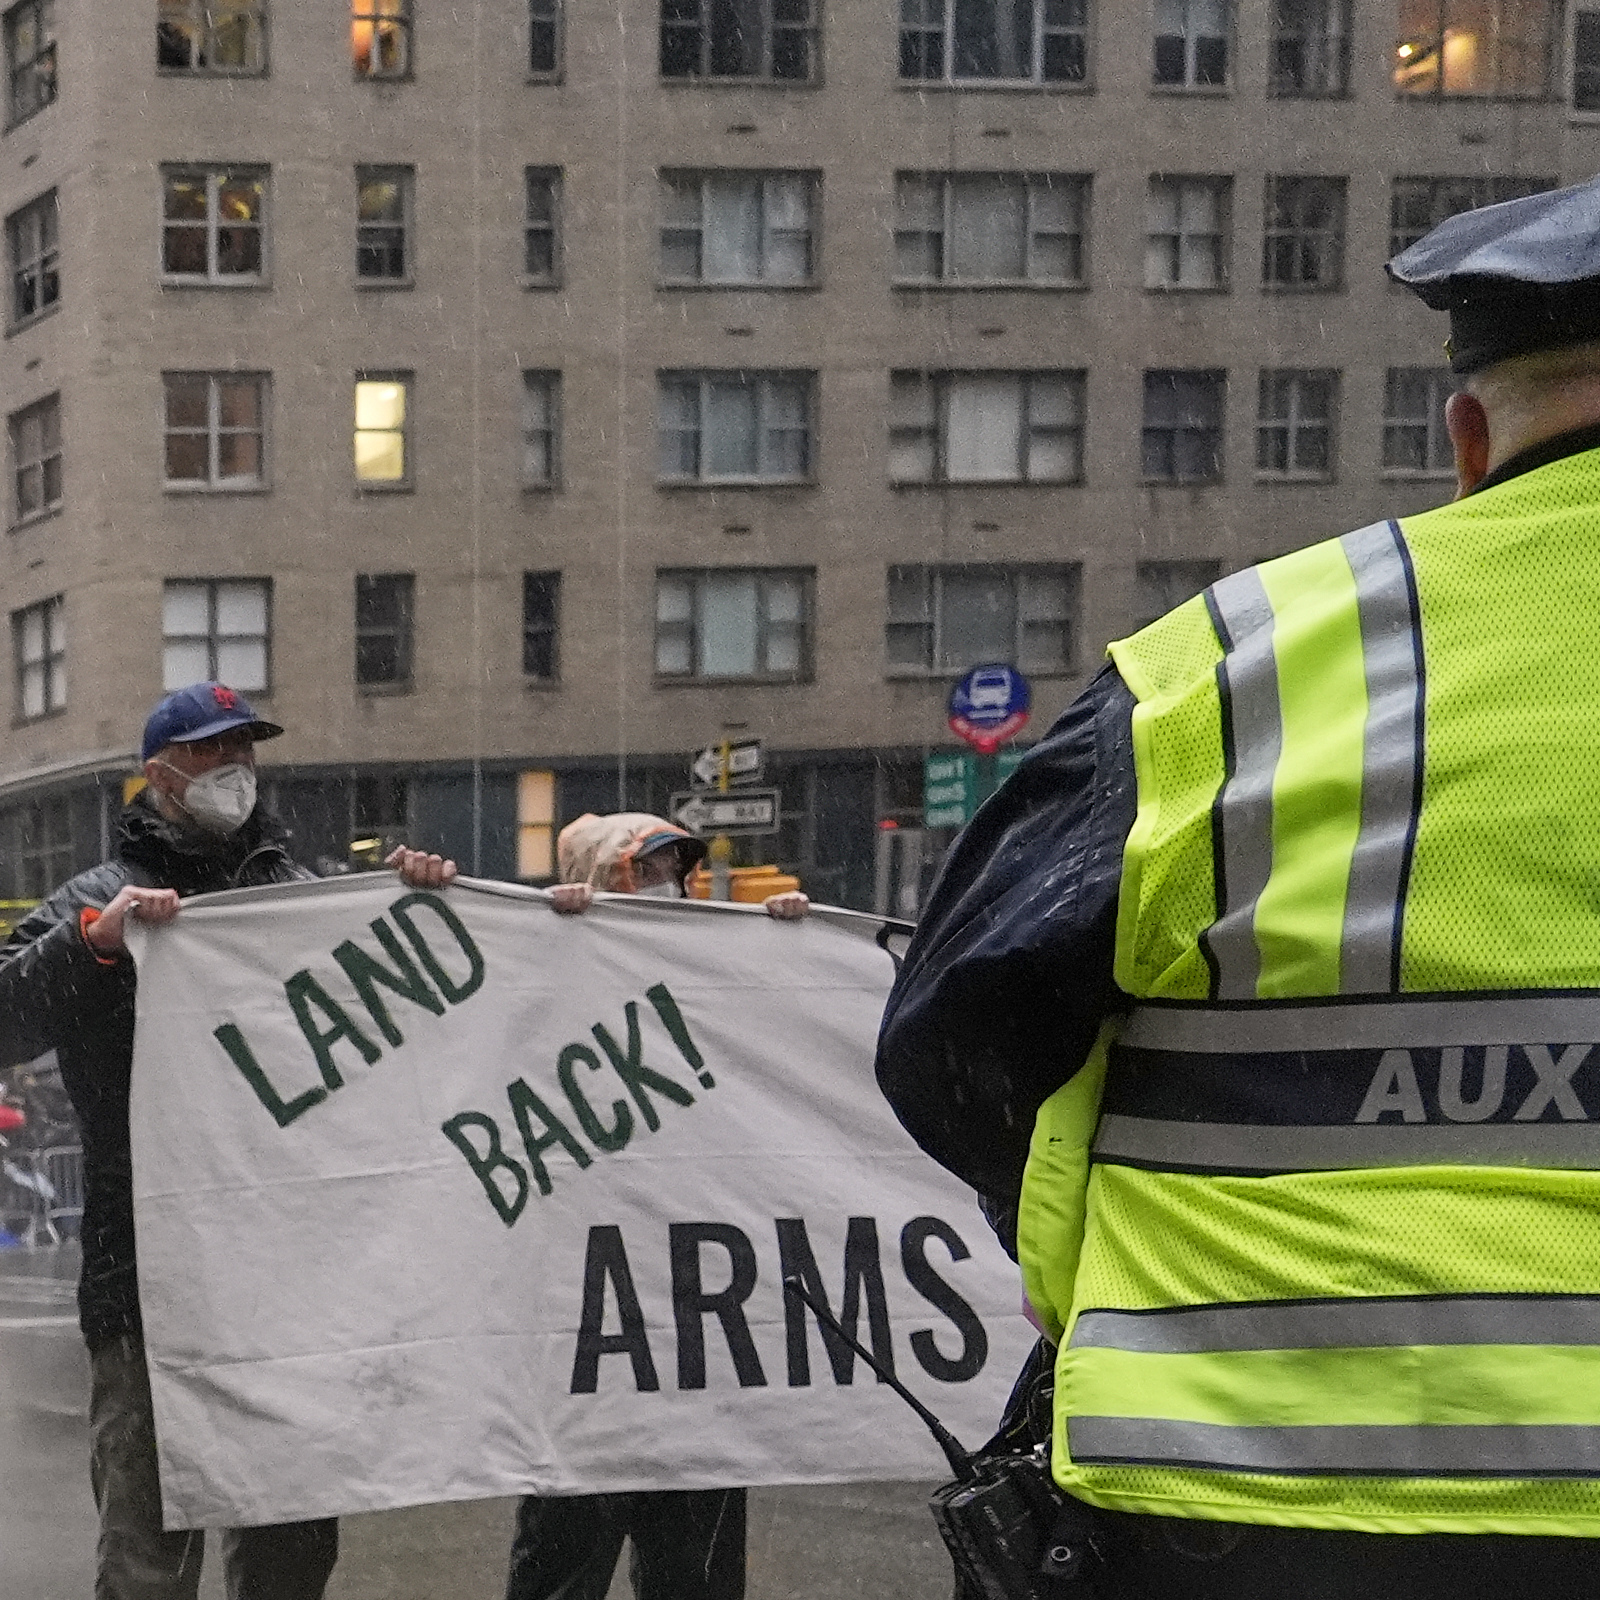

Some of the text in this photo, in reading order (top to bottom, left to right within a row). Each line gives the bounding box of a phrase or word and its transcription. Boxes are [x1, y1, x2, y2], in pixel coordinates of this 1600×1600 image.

[213, 892, 486, 1128] LAND
[442, 983, 718, 1229] BACK!
[1354, 1044, 1594, 1123] AUX
[571, 1215, 989, 1395] ARMS
